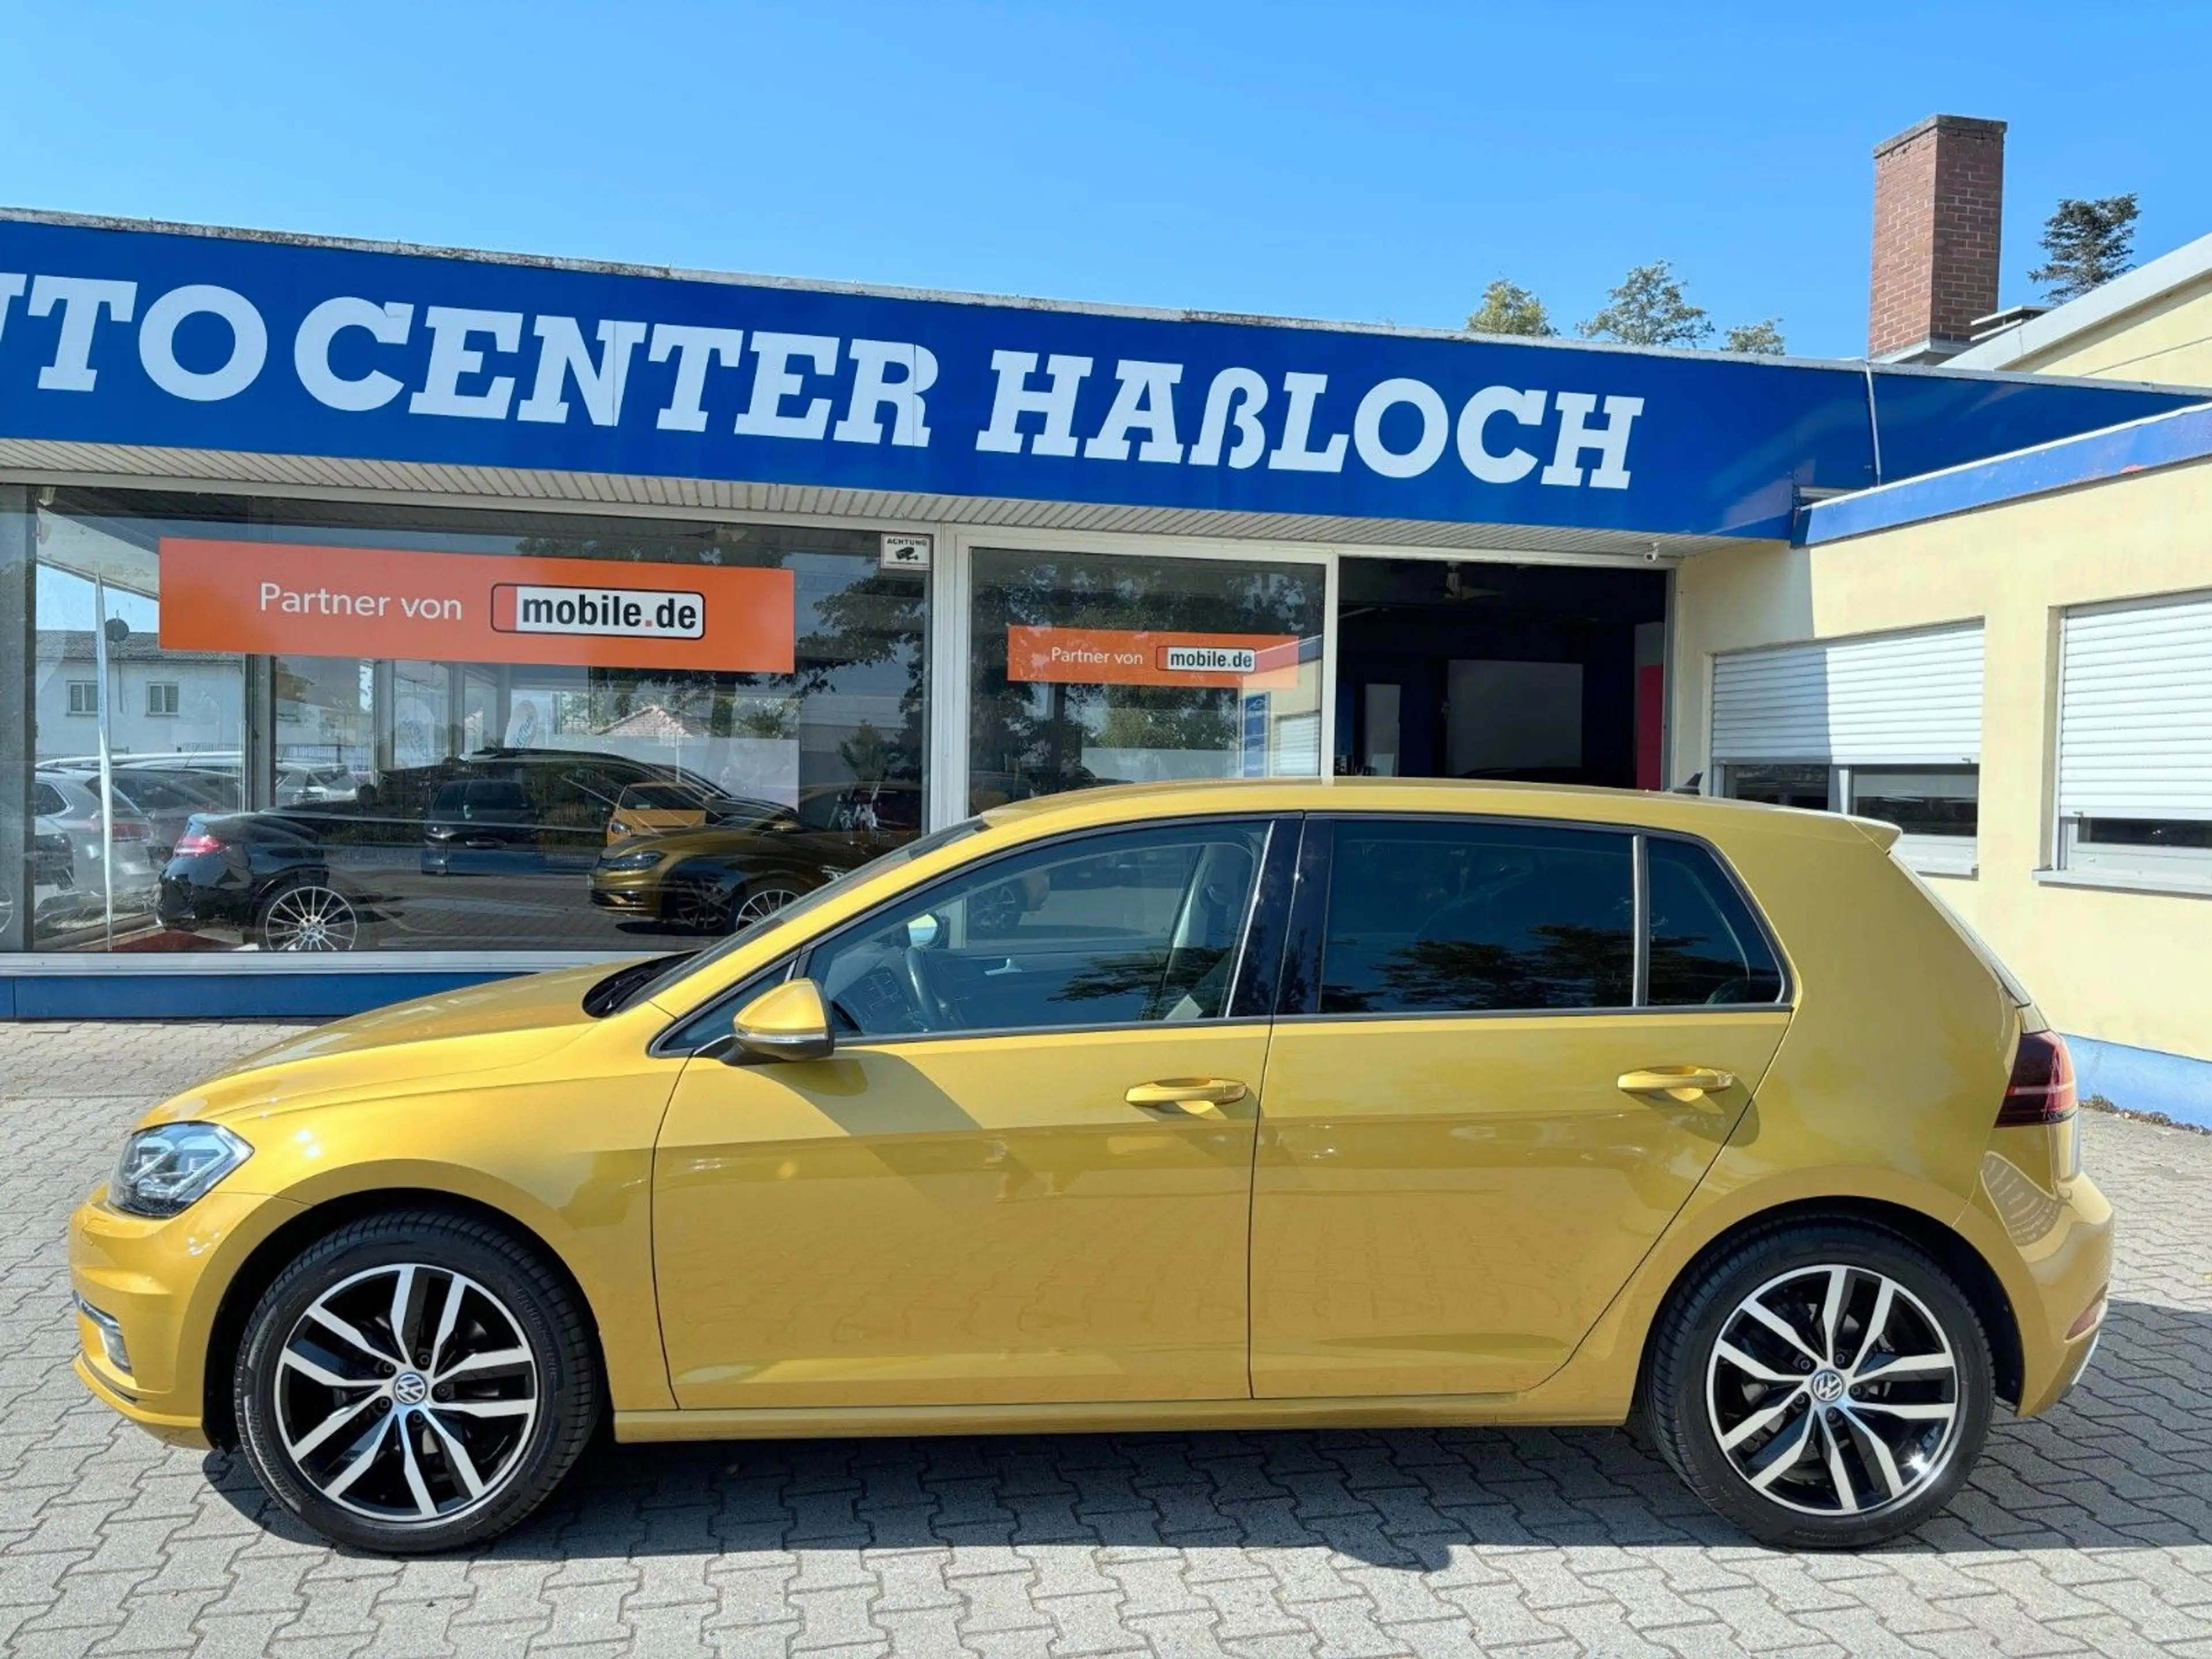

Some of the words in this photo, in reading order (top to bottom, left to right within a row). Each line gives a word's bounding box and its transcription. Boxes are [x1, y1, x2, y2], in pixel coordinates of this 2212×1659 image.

[0, 273, 268, 402] TO
[294, 297, 938, 448] CENTER
[975, 349, 1645, 489] HAßLOCH
[887, 537, 927, 546] ACHTUNG
[260, 582, 391, 616] Partner
[400, 597, 462, 620] von
[522, 594, 697, 630] mobile.de
[1051, 646, 1110, 664] Partner
[1113, 653, 1143, 665] von
[1170, 650, 1252, 668] mobile.de
